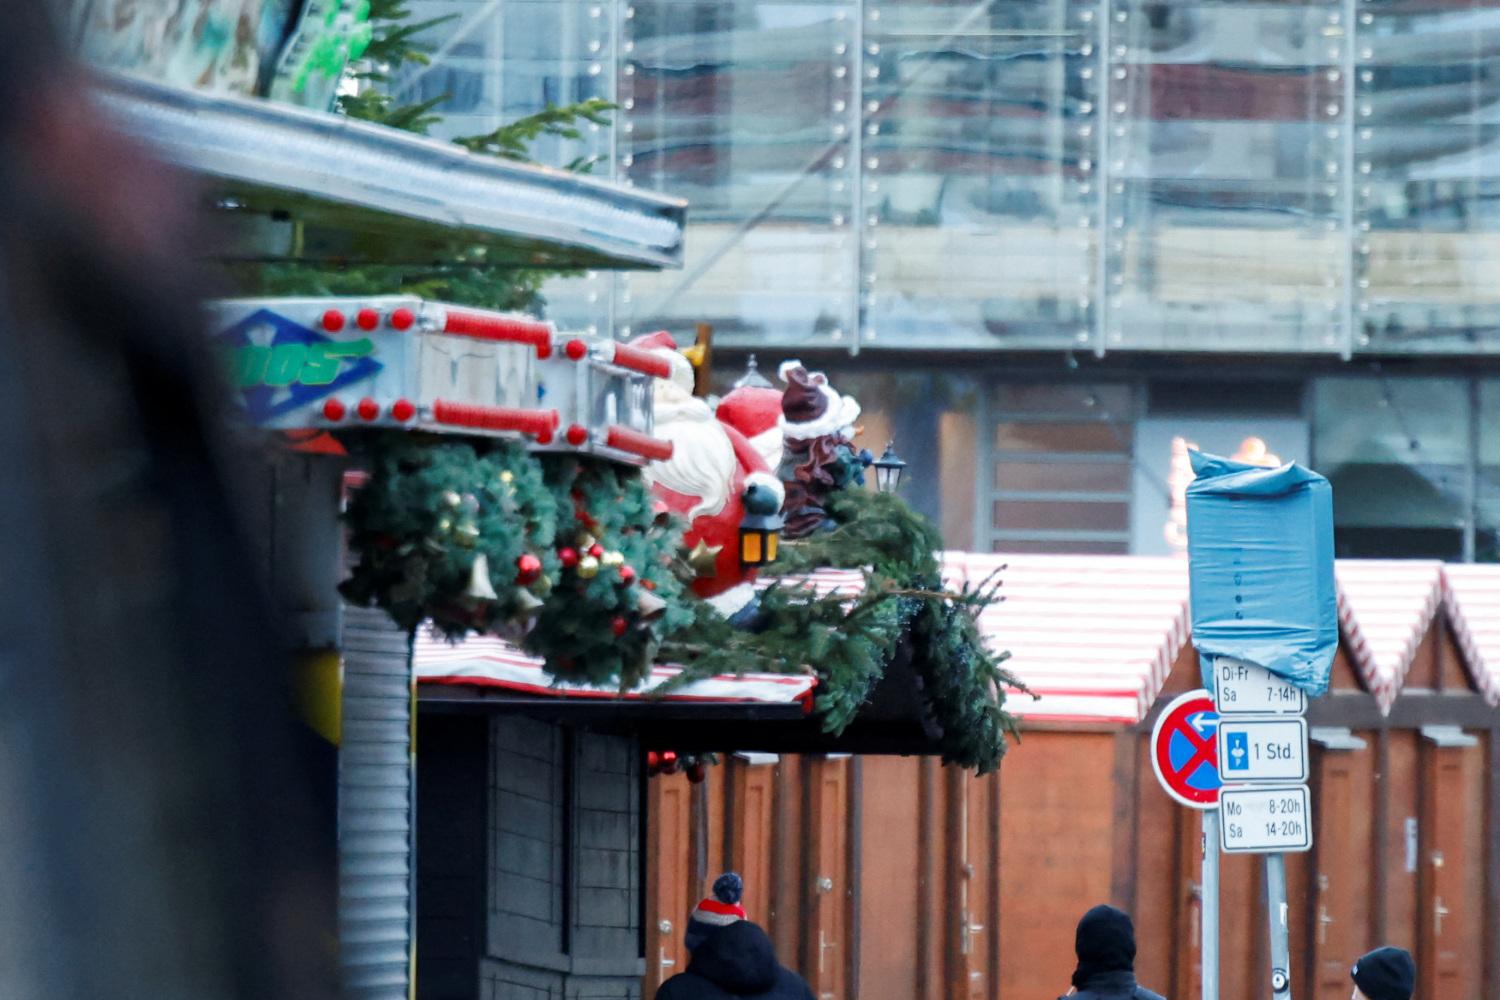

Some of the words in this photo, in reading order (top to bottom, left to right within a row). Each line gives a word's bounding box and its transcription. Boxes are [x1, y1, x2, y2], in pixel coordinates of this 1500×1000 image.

[1222, 666, 1249, 681] Di-Fr
[1223, 687, 1237, 702] Sa
[1267, 687, 1296, 702] 7-14h
[1254, 743, 1260, 760] 1
[1227, 801, 1242, 816] Mo
[1269, 799, 1300, 814] 8-20h
[1229, 823, 1243, 838] Sa
[1265, 821, 1302, 836] 14-20h
